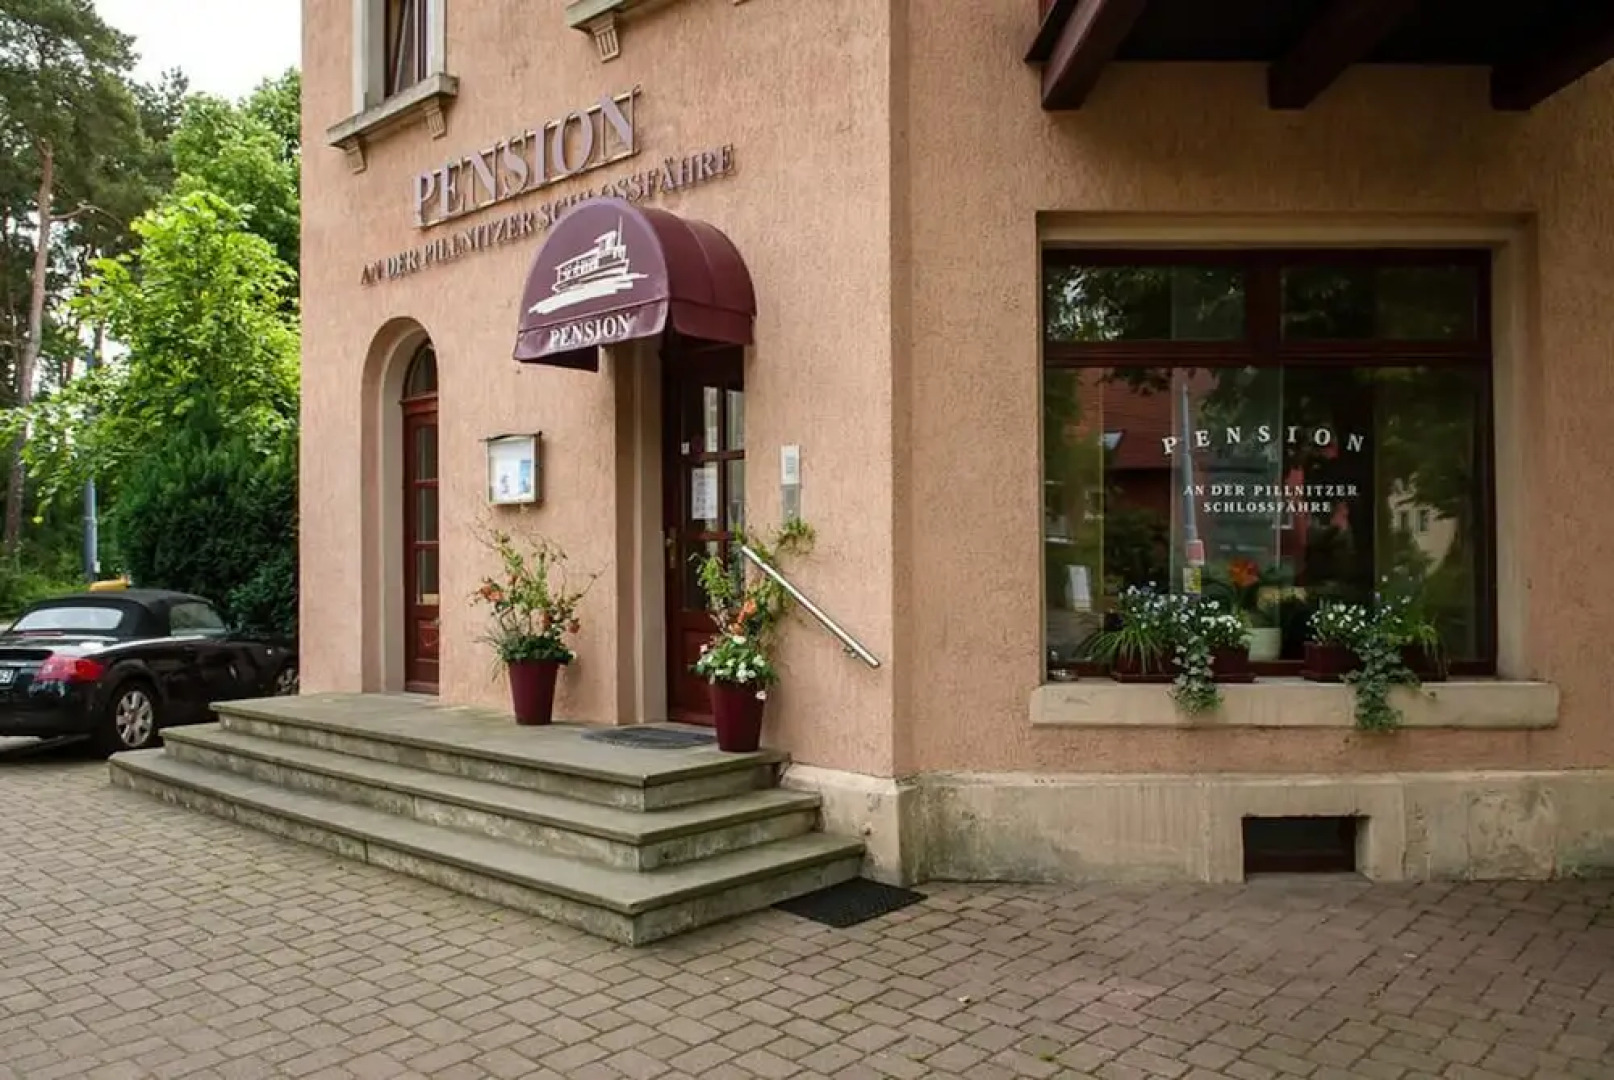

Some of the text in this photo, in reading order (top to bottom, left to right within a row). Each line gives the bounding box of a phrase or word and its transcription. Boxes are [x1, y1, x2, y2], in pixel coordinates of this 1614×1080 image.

[411, 85, 642, 229] PENSION
[361, 260, 382, 286] AN
[385, 248, 421, 280] DER
[422, 211, 536, 269] PILLNITZER
[549, 313, 637, 348] PENSION
[1161, 425, 1364, 454] PENSION
[1183, 484, 1358, 497] AN DER PILLNITZER
